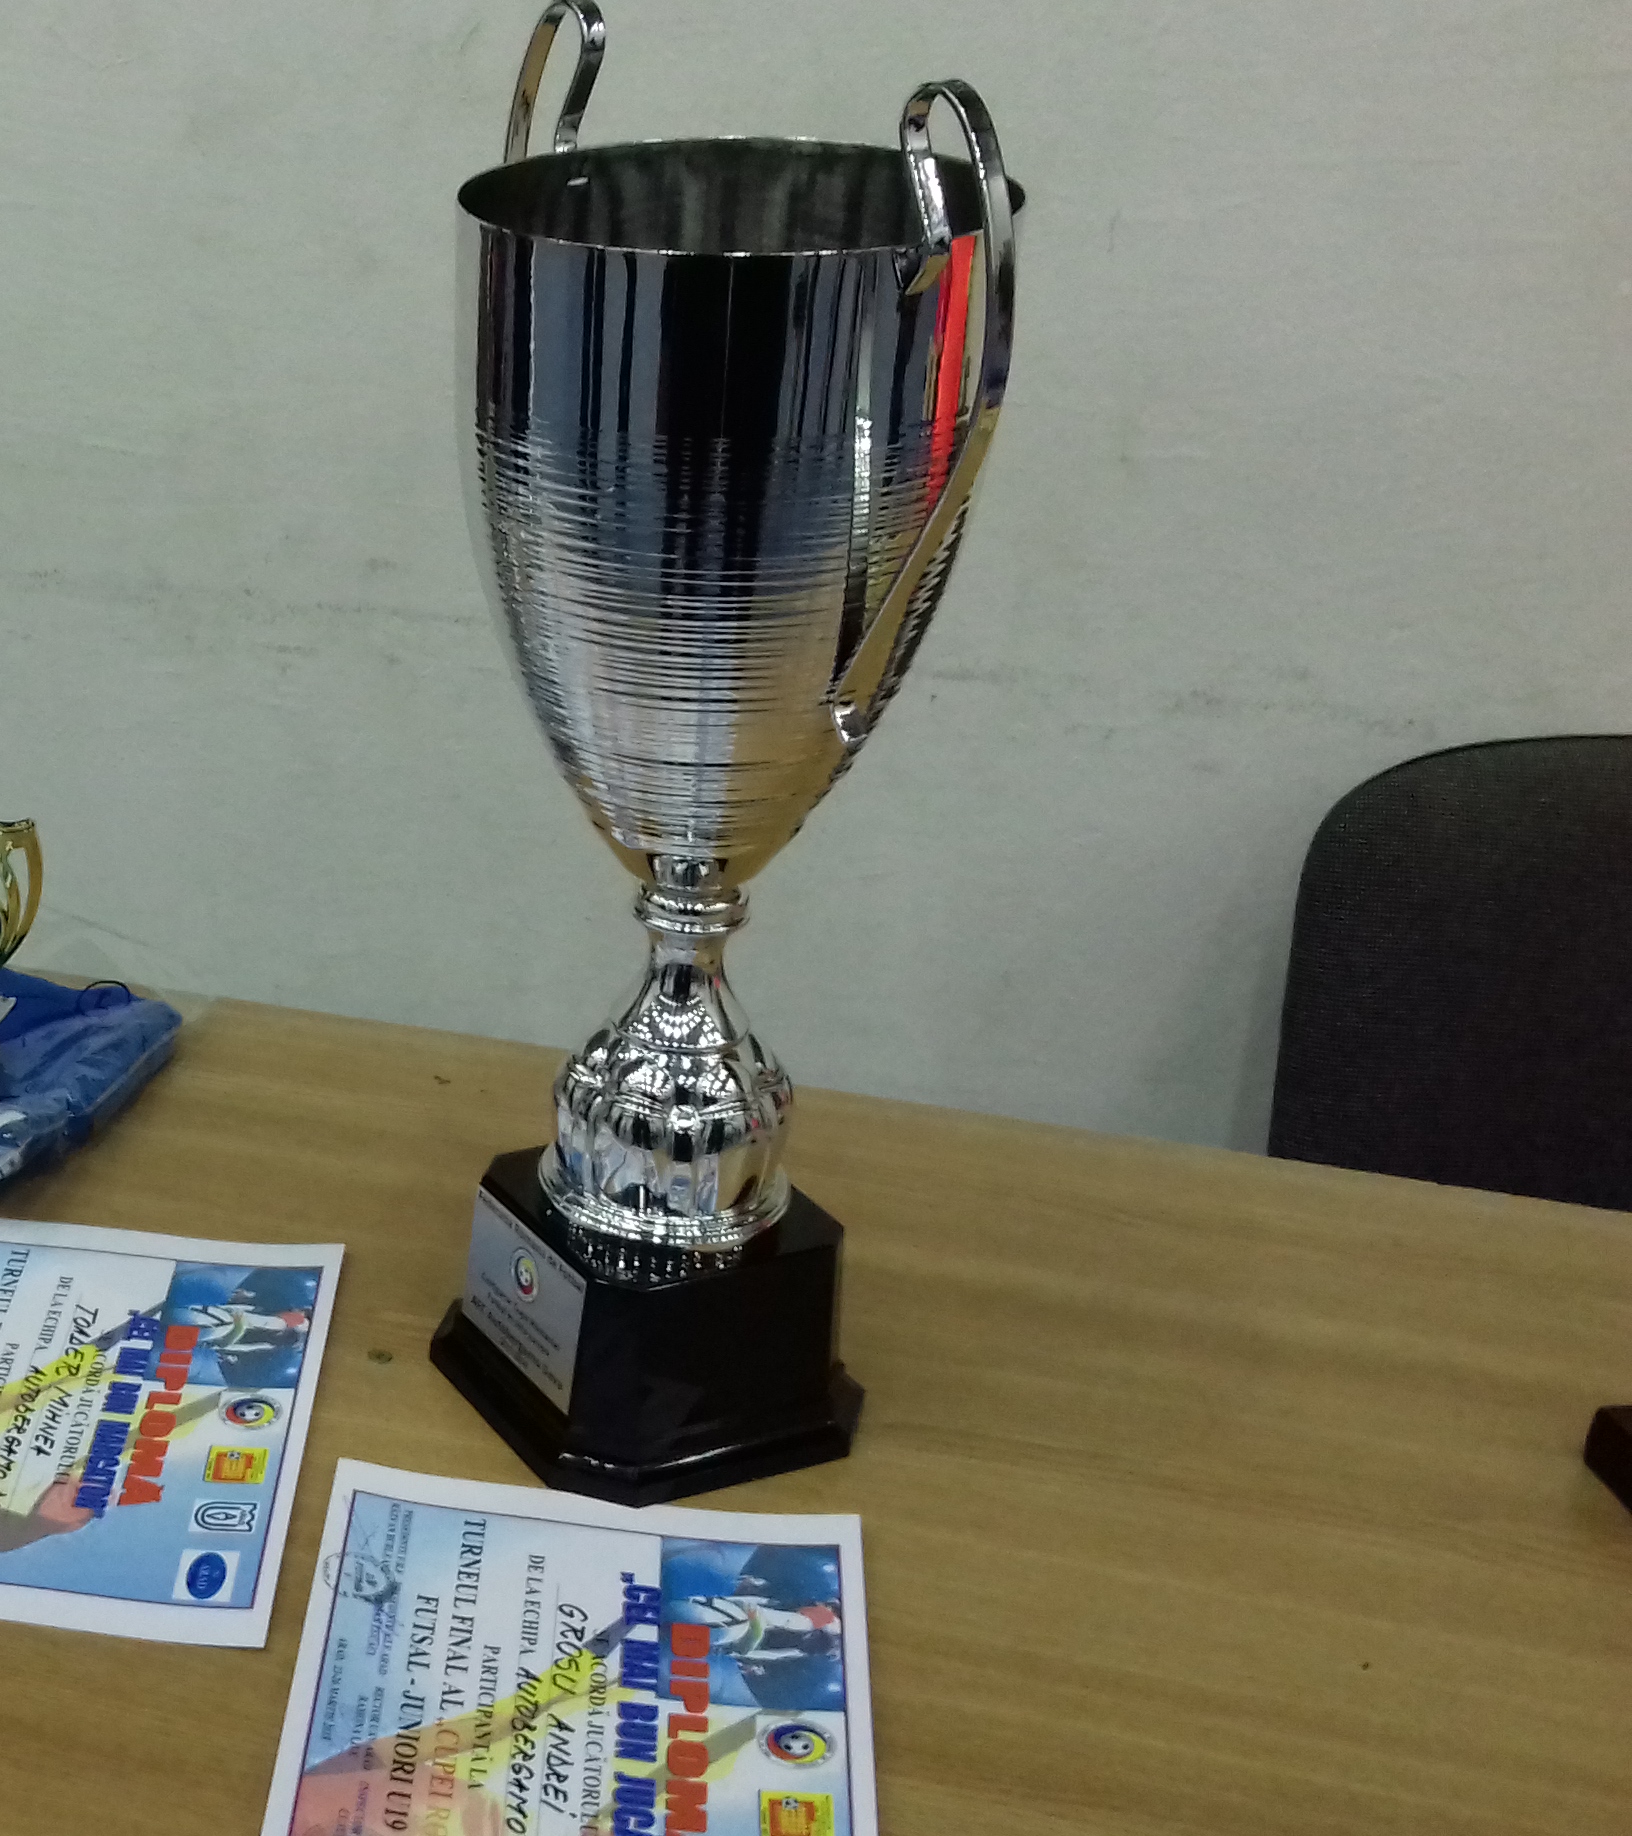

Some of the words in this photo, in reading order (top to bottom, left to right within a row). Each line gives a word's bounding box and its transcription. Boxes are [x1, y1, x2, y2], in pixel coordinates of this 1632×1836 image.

[49, 1293, 68, 1307] LA
[55, 1276, 74, 1291] DE
[33, 1309, 62, 1351] ECHIPA
[451, 1516, 487, 1609] TURNEUL
[523, 1576, 543, 1595] LA
[526, 1554, 545, 1573] DE
[404, 1594, 440, 1673] FUTSAL
[443, 1613, 475, 1676] FINAL
[517, 1598, 541, 1655] ECHIPA
[550, 1603, 589, 1695] GROSU
[618, 1639, 660, 1692] MAI
[438, 1681, 466, 1711] AL
[387, 1689, 426, 1782] JUNIORI
[497, 1666, 543, 1833] AUTOBERGAMO
[614, 1701, 659, 1762] BUN
[663, 1622, 711, 1836] DIPLOM
[466, 1767, 486, 1789] LA
[578, 1720, 609, 1836] JUCĂTORULU
[379, 1790, 412, 1831] U19
